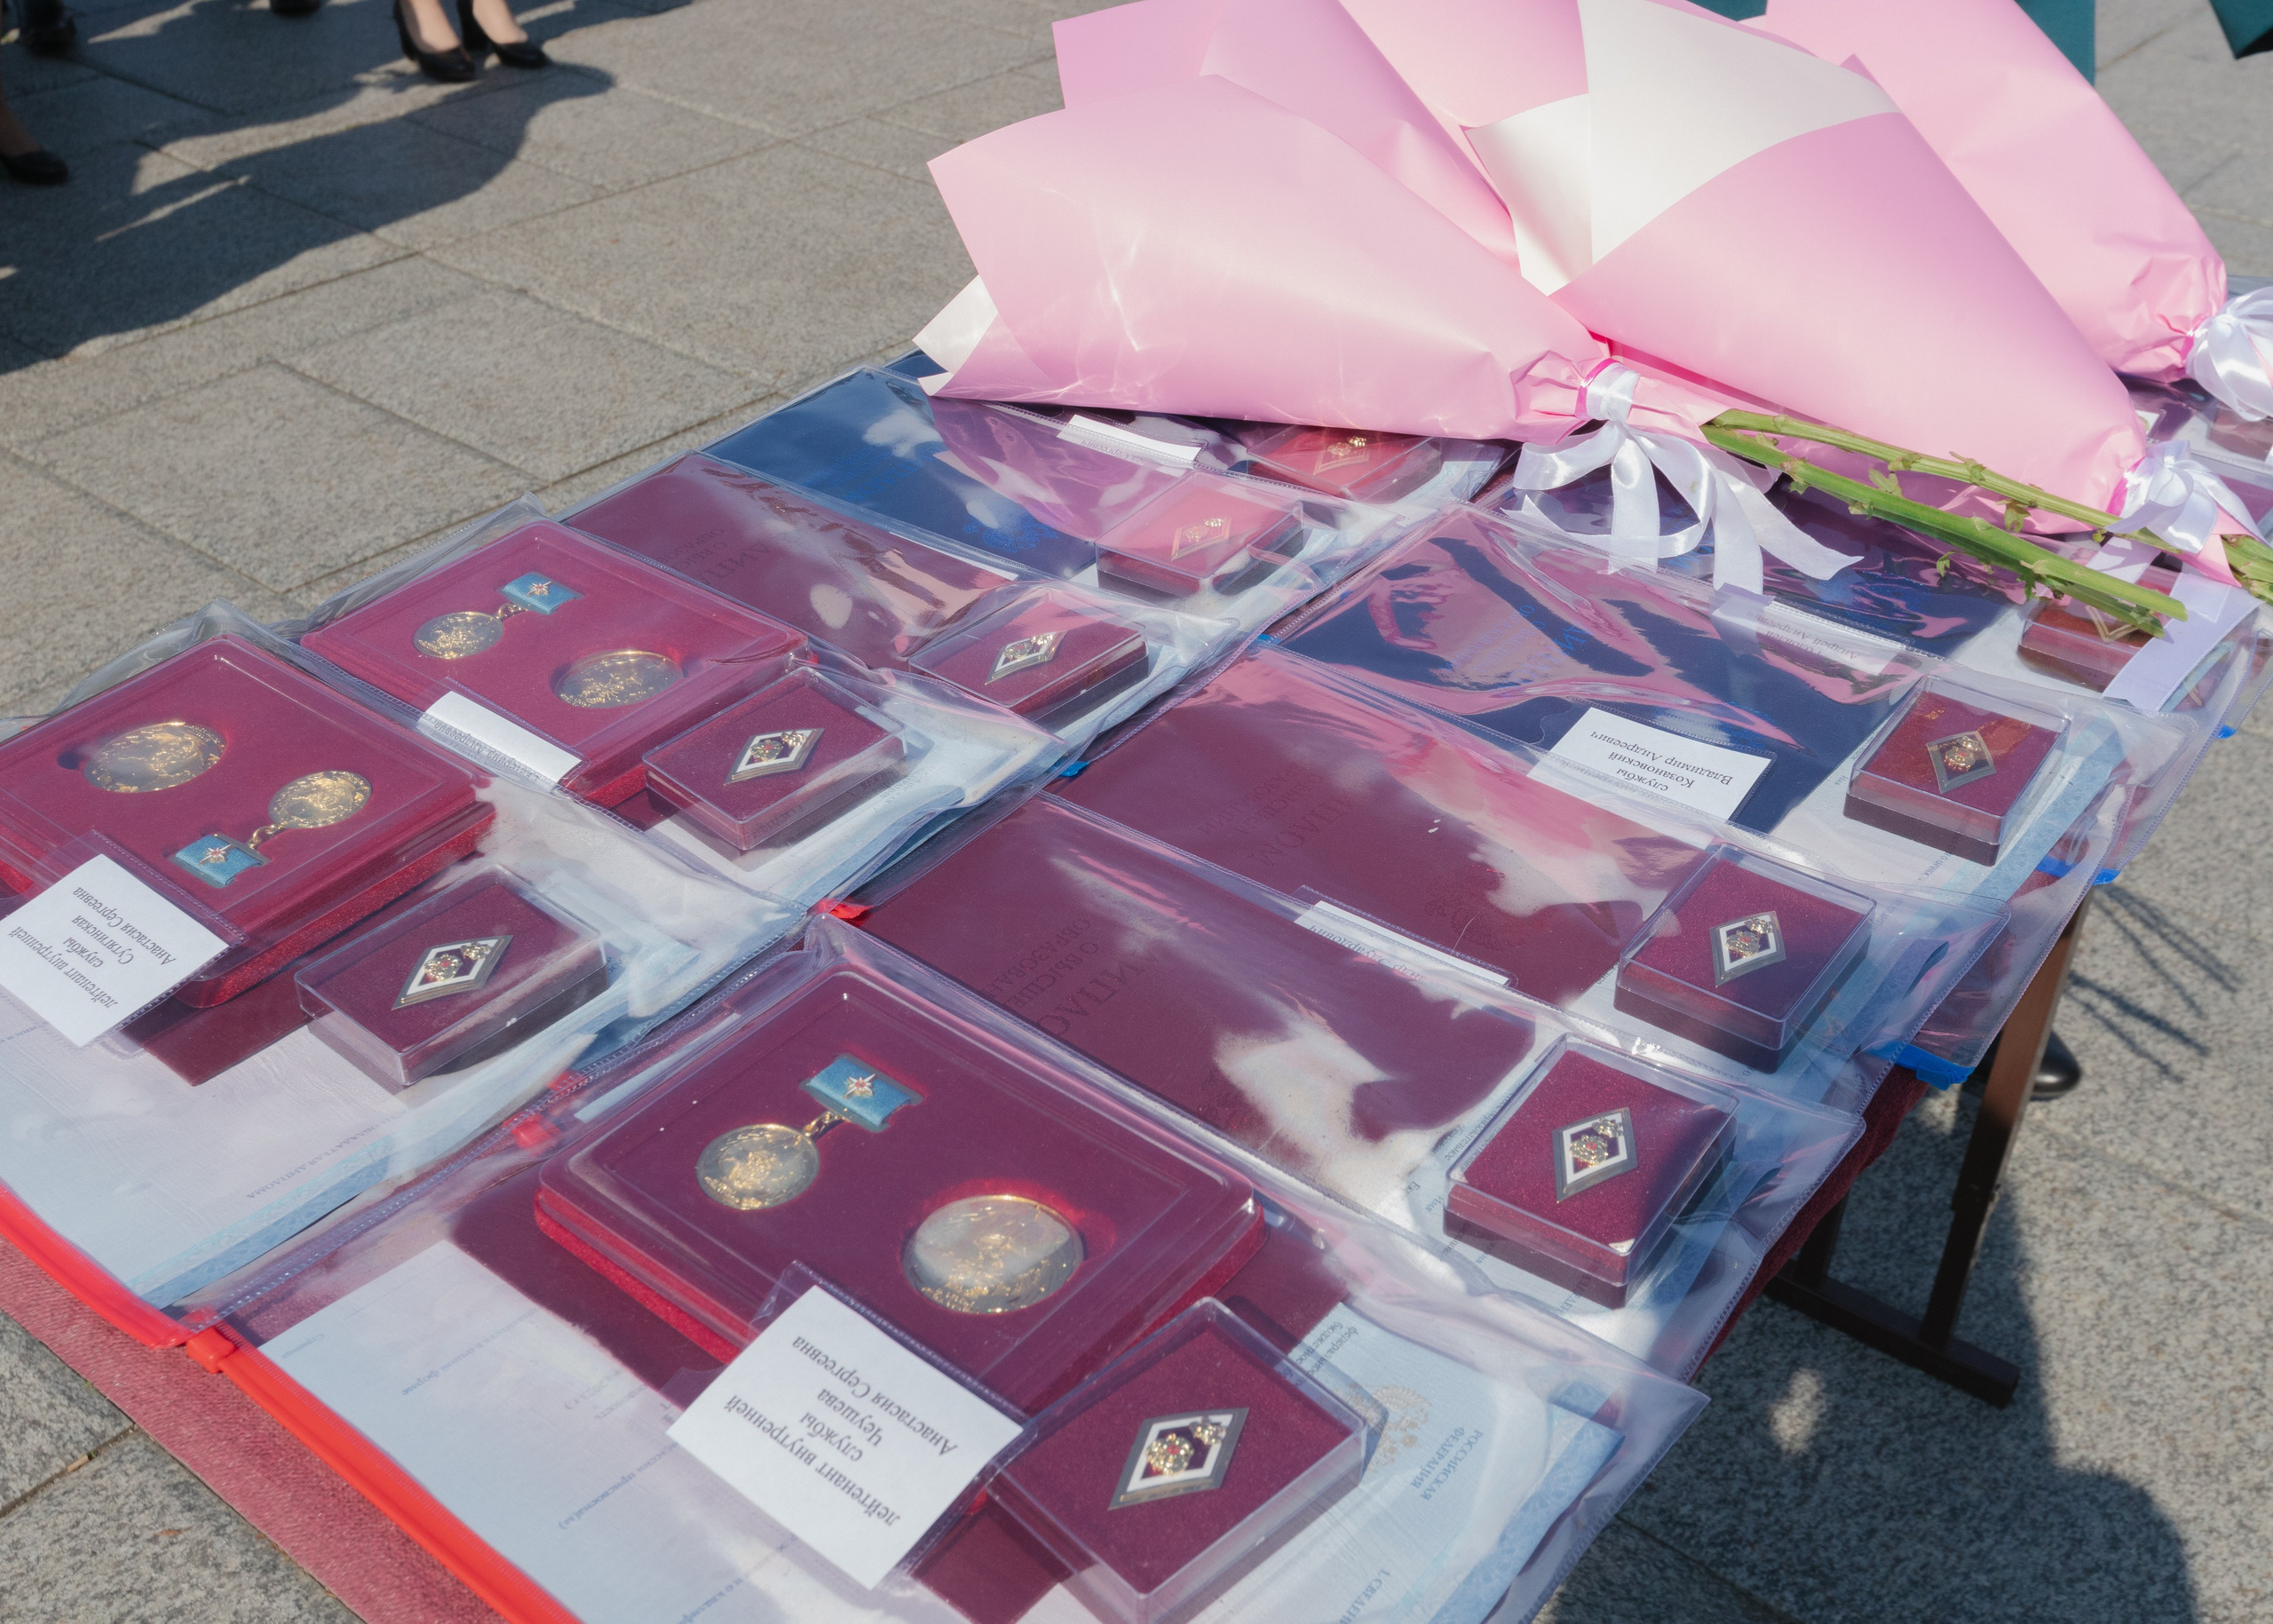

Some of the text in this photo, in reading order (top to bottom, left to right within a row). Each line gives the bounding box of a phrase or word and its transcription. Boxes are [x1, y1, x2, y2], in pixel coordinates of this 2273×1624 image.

[1589, 730, 1734, 786] Владимир Андреевич
[1606, 750, 1696, 789] Козановский
[1615, 767, 1669, 792] службы
[61, 936, 105, 969] службы
[71, 915, 135, 965] Сутягинская
[72, 886, 178, 966] Анастасия Сергеевна
[6, 926, 119, 1009] лейтенант внутренней
[245, 1163, 308, 1200] ДИПЛОМА
[1295, 1320, 1344, 1367] бюджетное
[1305, 1326, 1359, 1376] федеральное
[790, 1335, 959, 1457] Анастасия Сергеевна
[816, 1388, 883, 1448] Чеушева
[722, 1393, 818, 1468] внутренней
[798, 1411, 864, 1464] службы
[1409, 1426, 1465, 1490] ФЕДЕРАЦИЯ
[1419, 1429, 1485, 1501] РОССИЙСКАЯ
[814, 1461, 902, 1527] лейтенант
